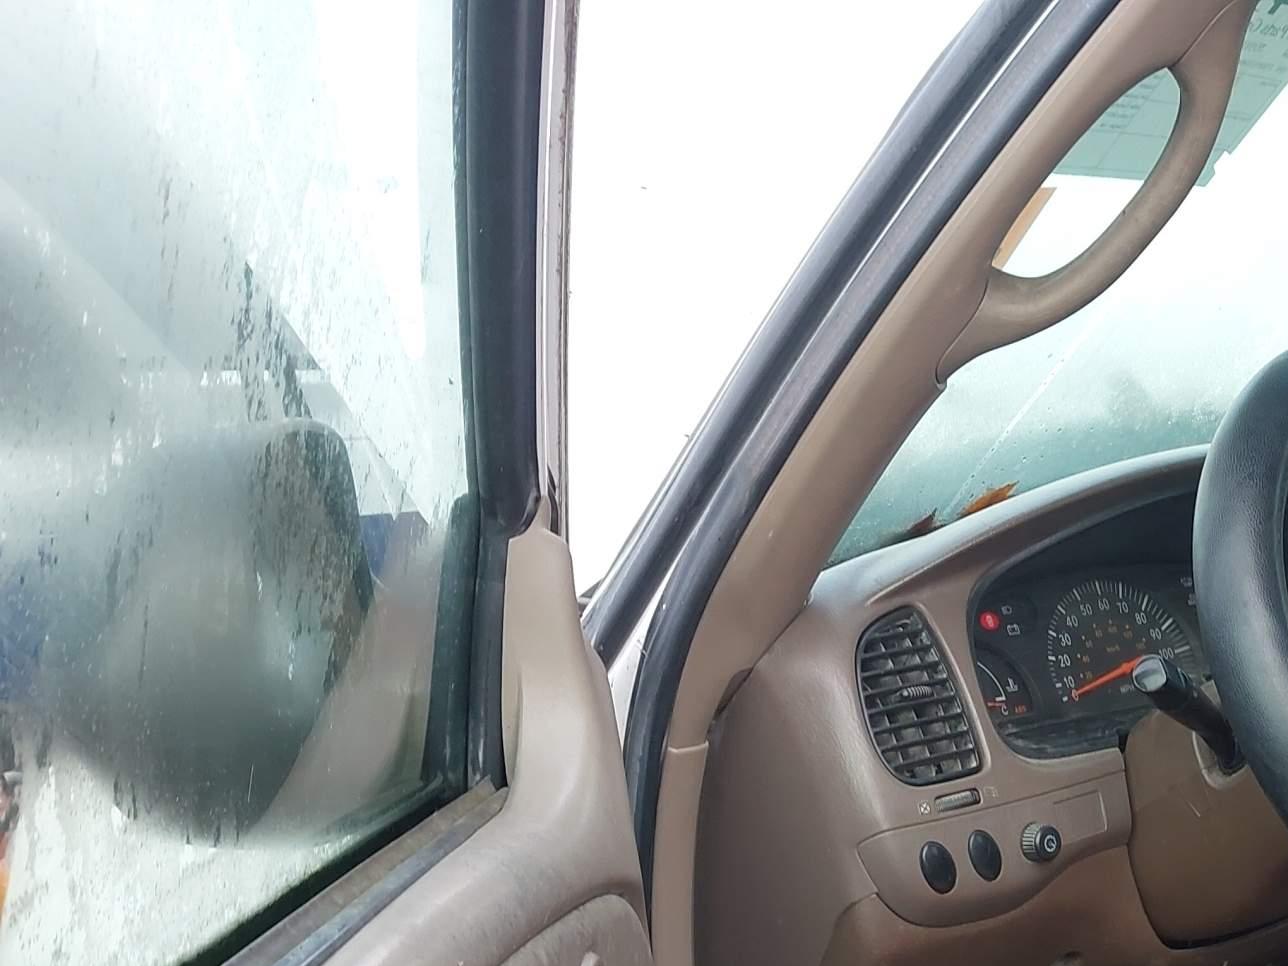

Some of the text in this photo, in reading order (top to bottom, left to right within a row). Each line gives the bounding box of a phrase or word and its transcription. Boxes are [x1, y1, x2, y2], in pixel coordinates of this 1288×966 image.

[1079, 604, 1093, 616] 50
[1098, 599, 1110, 611] 60
[1116, 601, 1129, 614] 70
[1066, 615, 1079, 628] 40
[1135, 612, 1147, 625] 80
[1058, 633, 1072, 646] 30
[1149, 629, 1162, 640] 90
[1058, 654, 1071, 668] 20
[1063, 676, 1075, 689] 10
